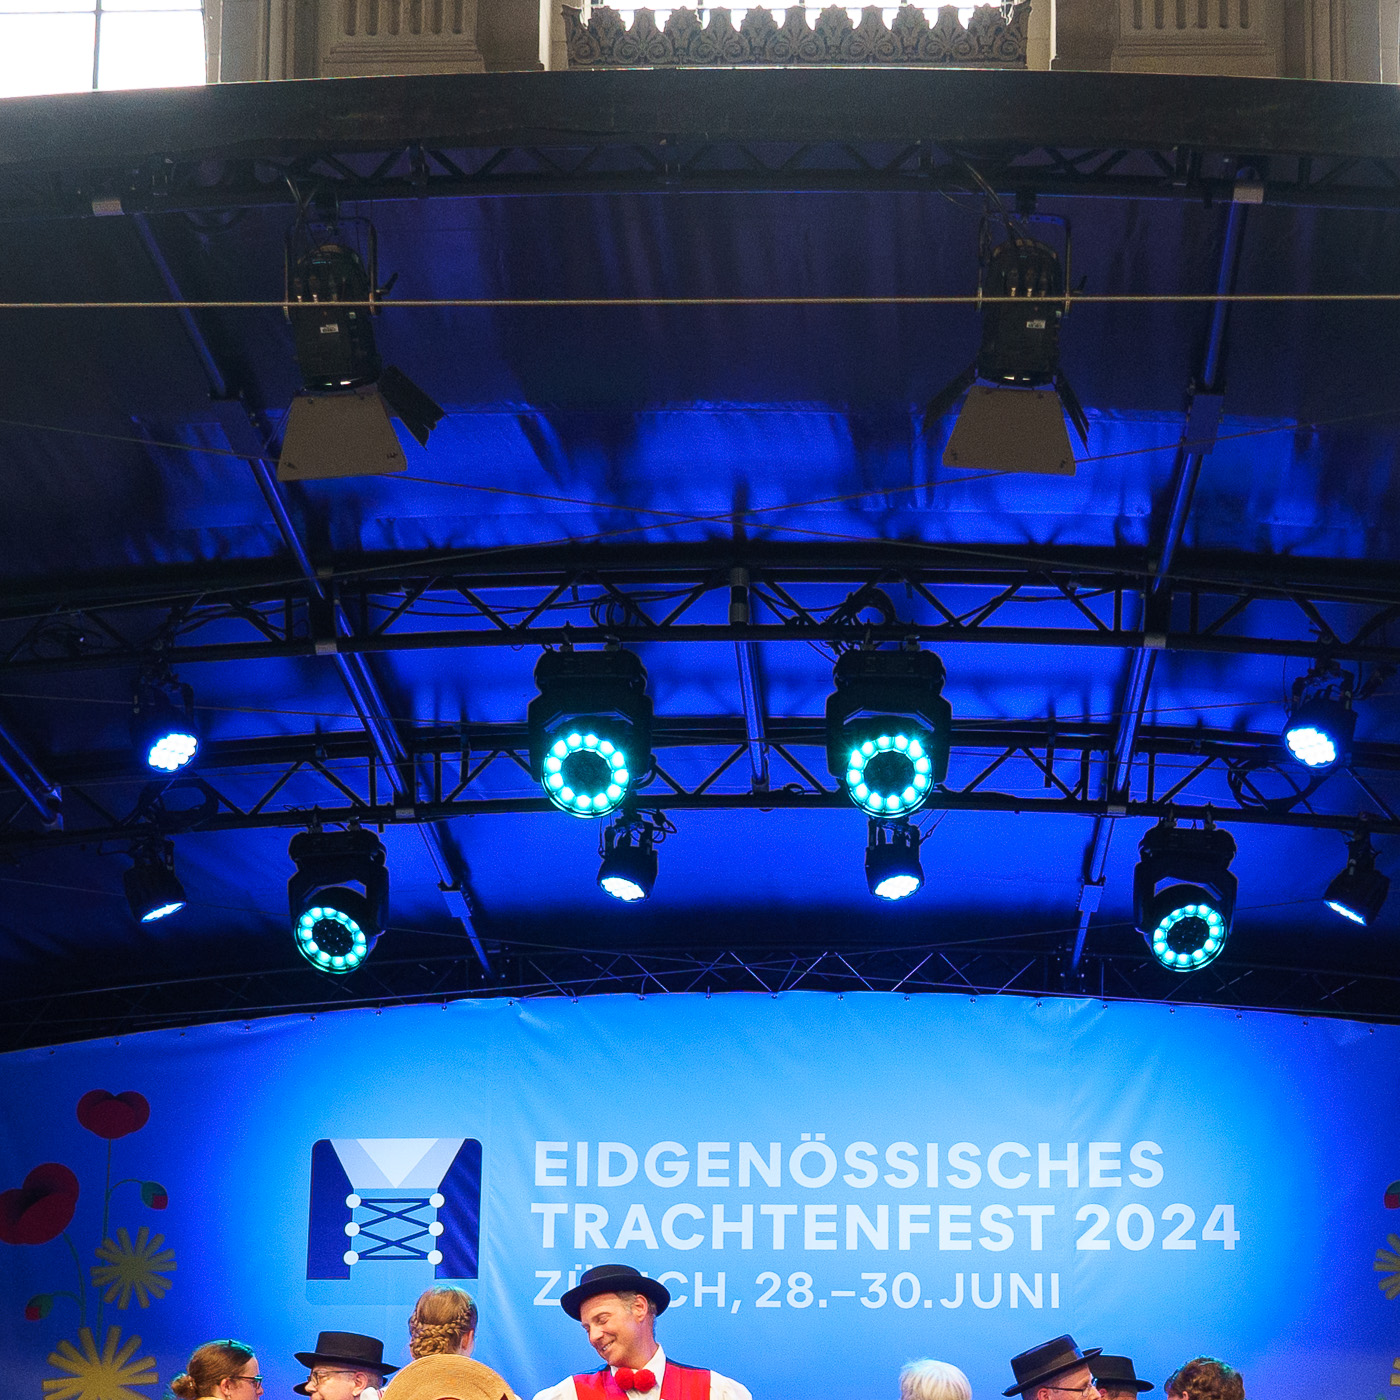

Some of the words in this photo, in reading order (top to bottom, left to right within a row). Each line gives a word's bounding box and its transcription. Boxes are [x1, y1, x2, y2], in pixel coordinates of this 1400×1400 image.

[534, 1132, 1165, 1190] EIDGENÖSSISCHES
[530, 1202, 1056, 1251] TRACHTENFEST
[1075, 1203, 1241, 1251] 2024
